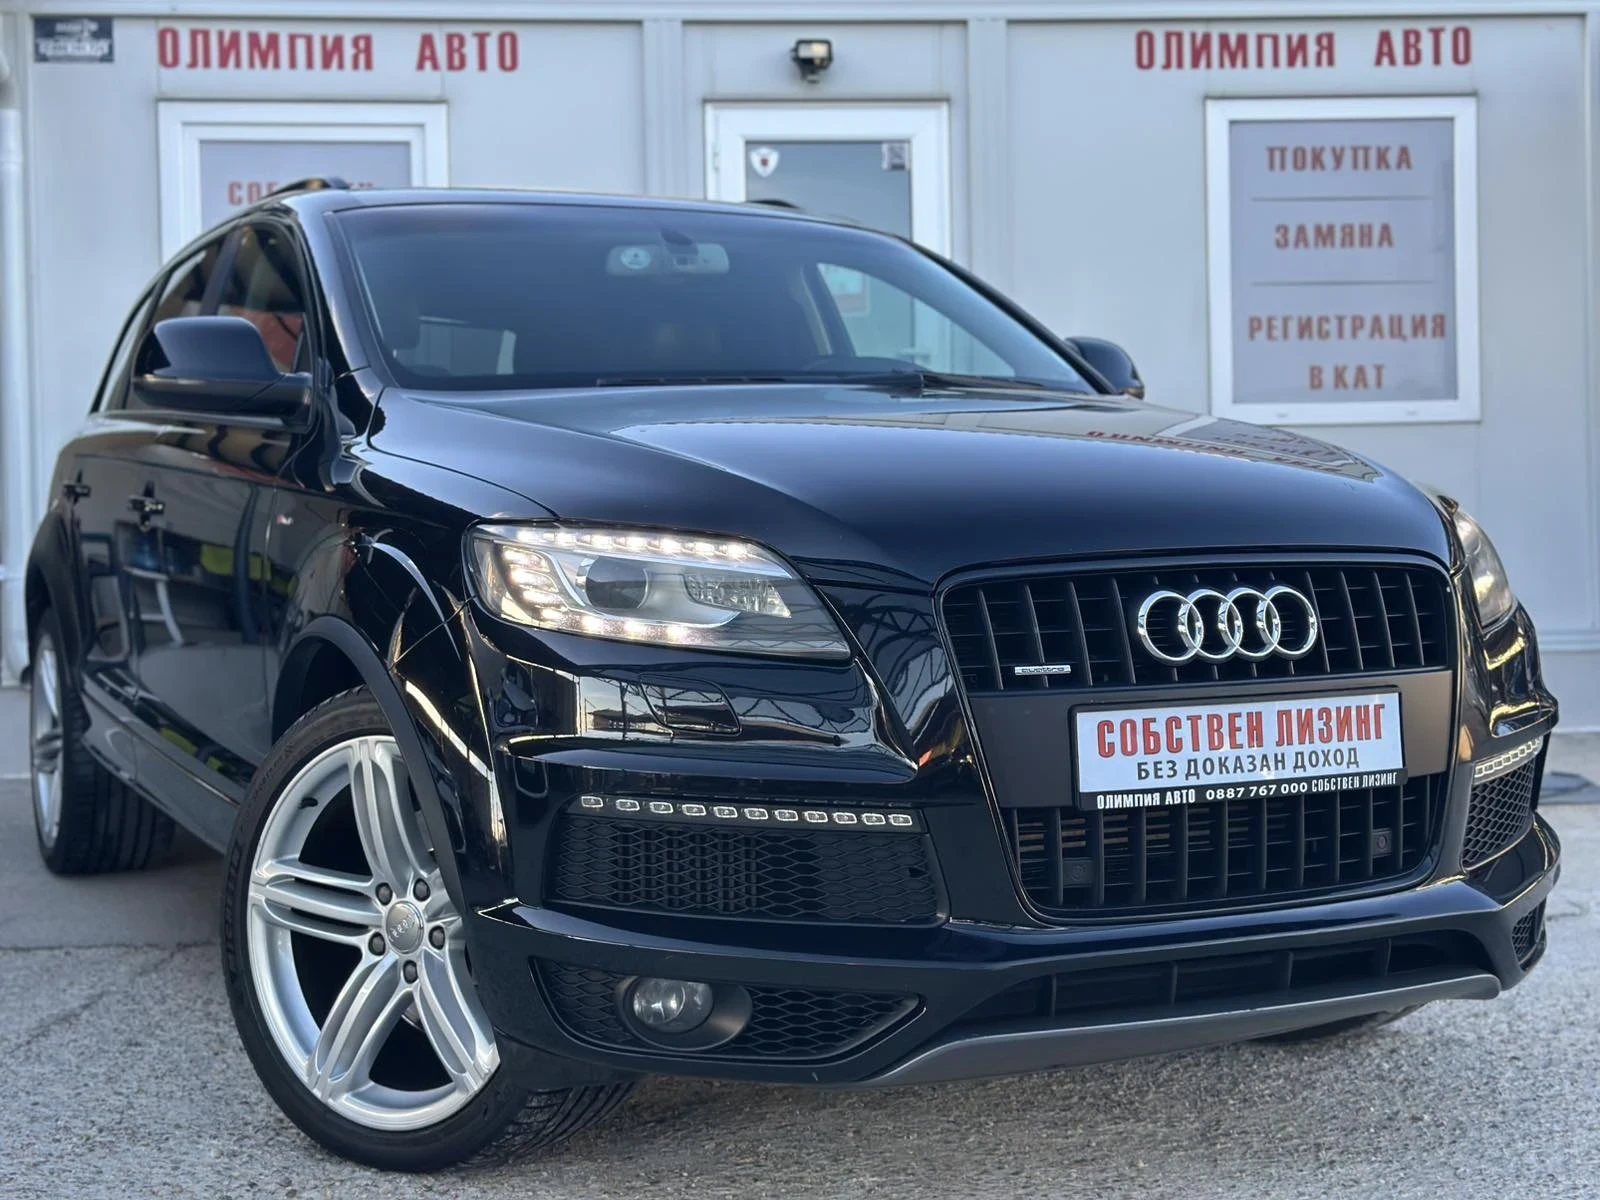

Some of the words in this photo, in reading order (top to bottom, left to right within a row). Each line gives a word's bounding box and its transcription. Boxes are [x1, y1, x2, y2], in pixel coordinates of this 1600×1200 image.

[158, 27, 375, 71] ОЛИМПИЯ
[416, 31, 520, 73] АВТО
[1135, 30, 1336, 71] ОЛИМПИЯ
[1374, 26, 1473, 67] АВТО
[1266, 145, 1413, 172] ПОКУПКА
[1274, 223, 1395, 250] ЗАМЯНА
[1248, 313, 1447, 342] РЕГИСТРАЦИЯ
[1309, 365, 1324, 390] В
[1333, 363, 1386, 390] КАТ
[1097, 711, 1264, 758] СОБСТВЕН
[1275, 703, 1386, 747] ЛИЗИНГ
[1137, 760, 1178, 781] БЕЗ
[1184, 752, 1286, 781] ДОКАЗАН
[1292, 747, 1360, 773] ДОХОД
[1096, 792, 1161, 810] ОЛИМПИЯ
[1164, 788, 1197, 806] АВТО
[1205, 787, 1246, 801] 0887
[1248, 784, 1278, 798] 767
[1280, 781, 1309, 795] 000
[1310, 775, 1361, 793] СОБСТВЕН
[1361, 771, 1399, 788] ЛИЗИНГ
